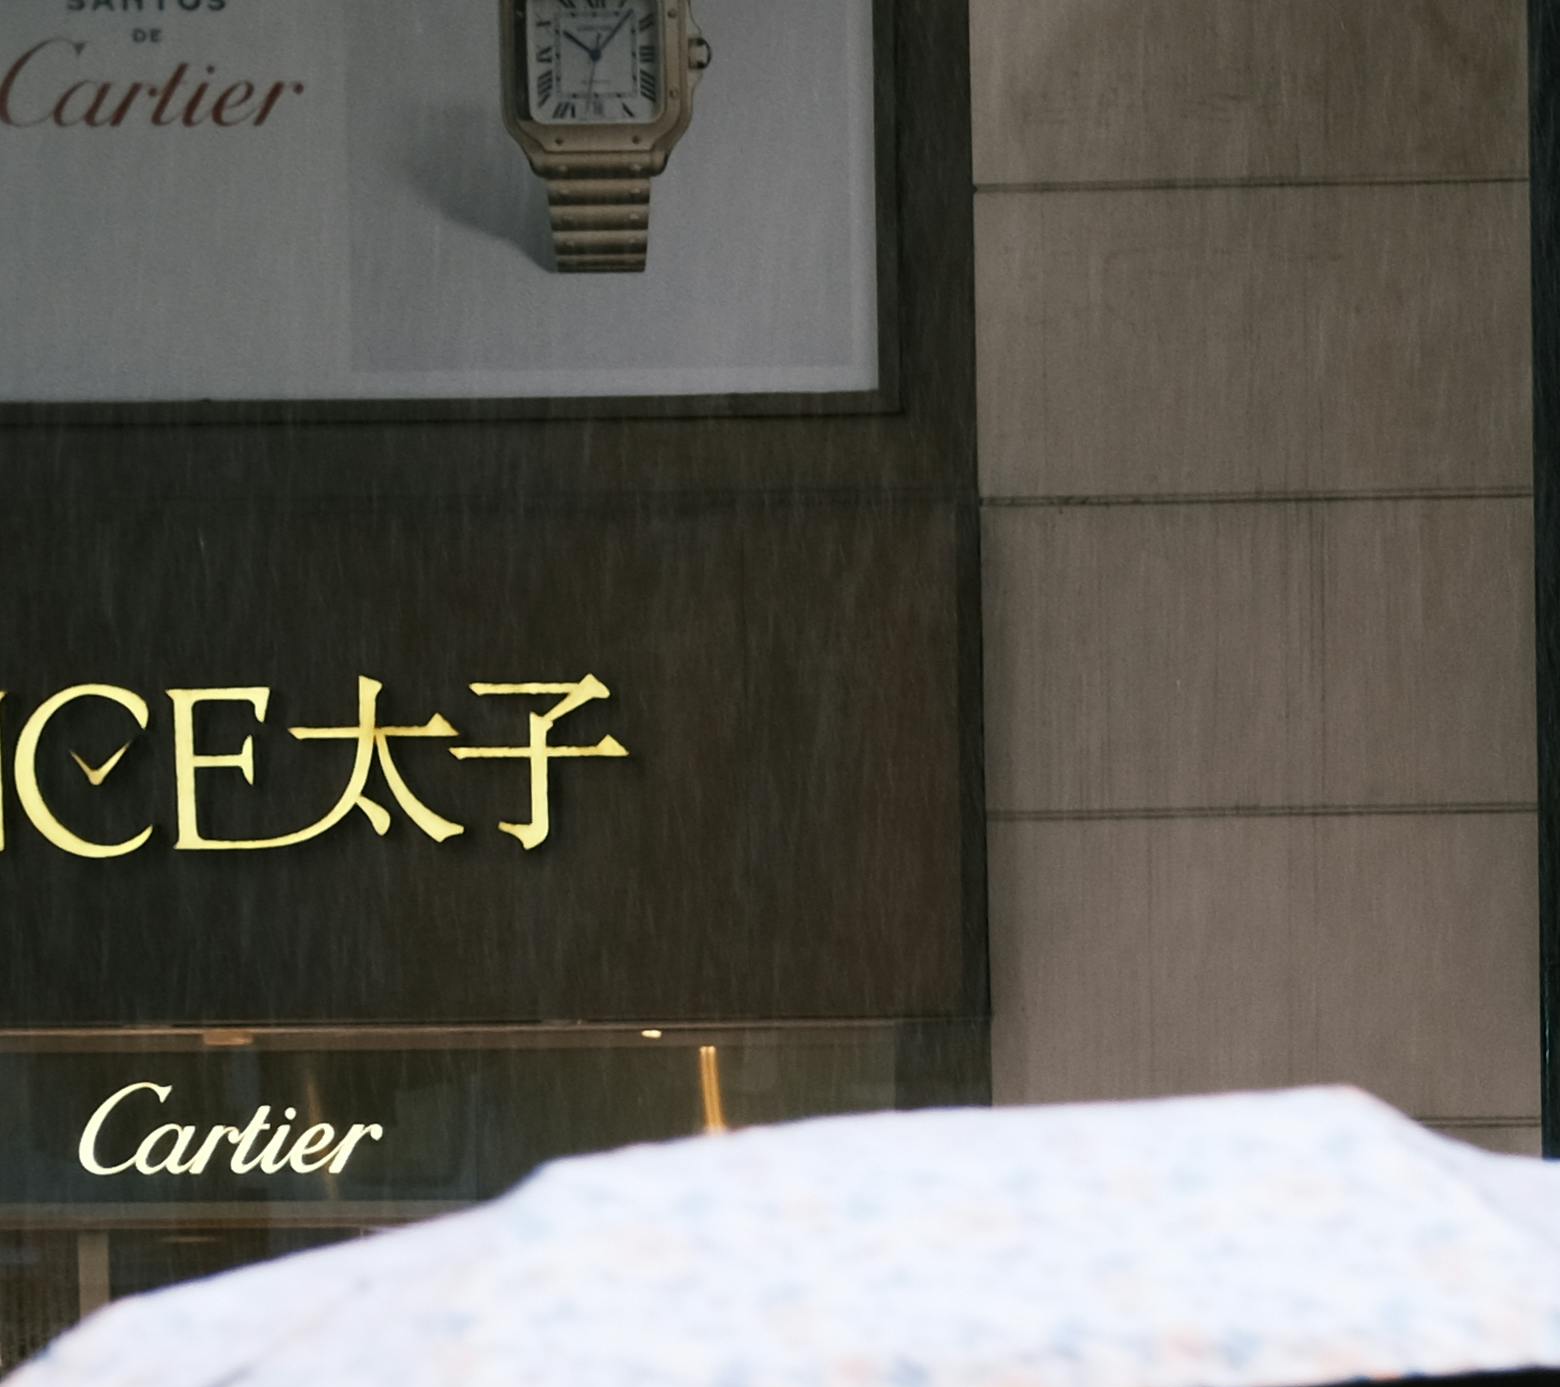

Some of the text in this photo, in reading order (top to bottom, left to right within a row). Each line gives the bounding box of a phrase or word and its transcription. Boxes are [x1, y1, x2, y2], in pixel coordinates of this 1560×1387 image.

[132, 28, 162, 43] DE
[0, 37, 304, 128] Cartier
[0, 673, 630, 859] CE太子
[77, 1081, 384, 1176] Cartier
